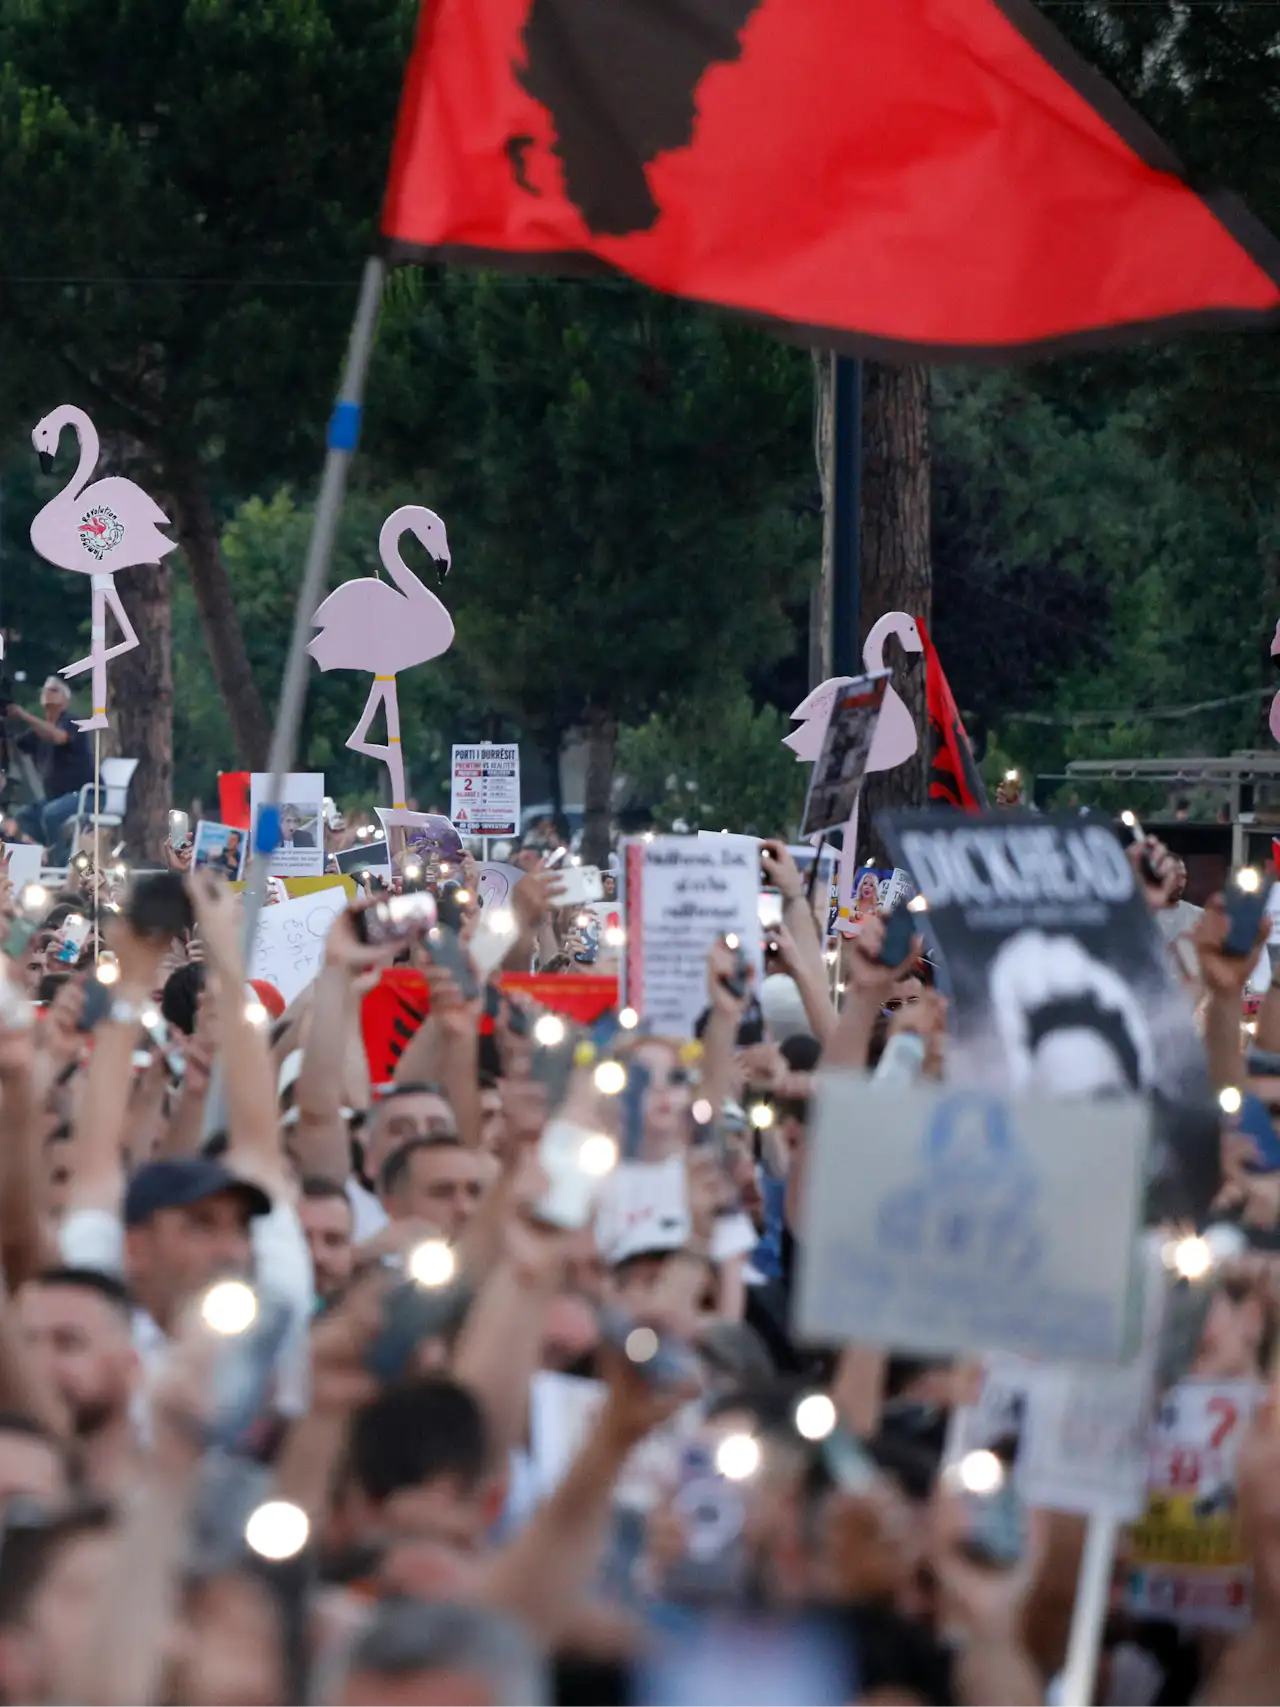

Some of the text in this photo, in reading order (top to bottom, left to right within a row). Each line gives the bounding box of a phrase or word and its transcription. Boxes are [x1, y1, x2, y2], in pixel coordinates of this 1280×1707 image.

[455, 749, 475, 760] PORTI
[464, 778, 473, 791] 2
[901, 825, 1134, 905] DICKHEAD
